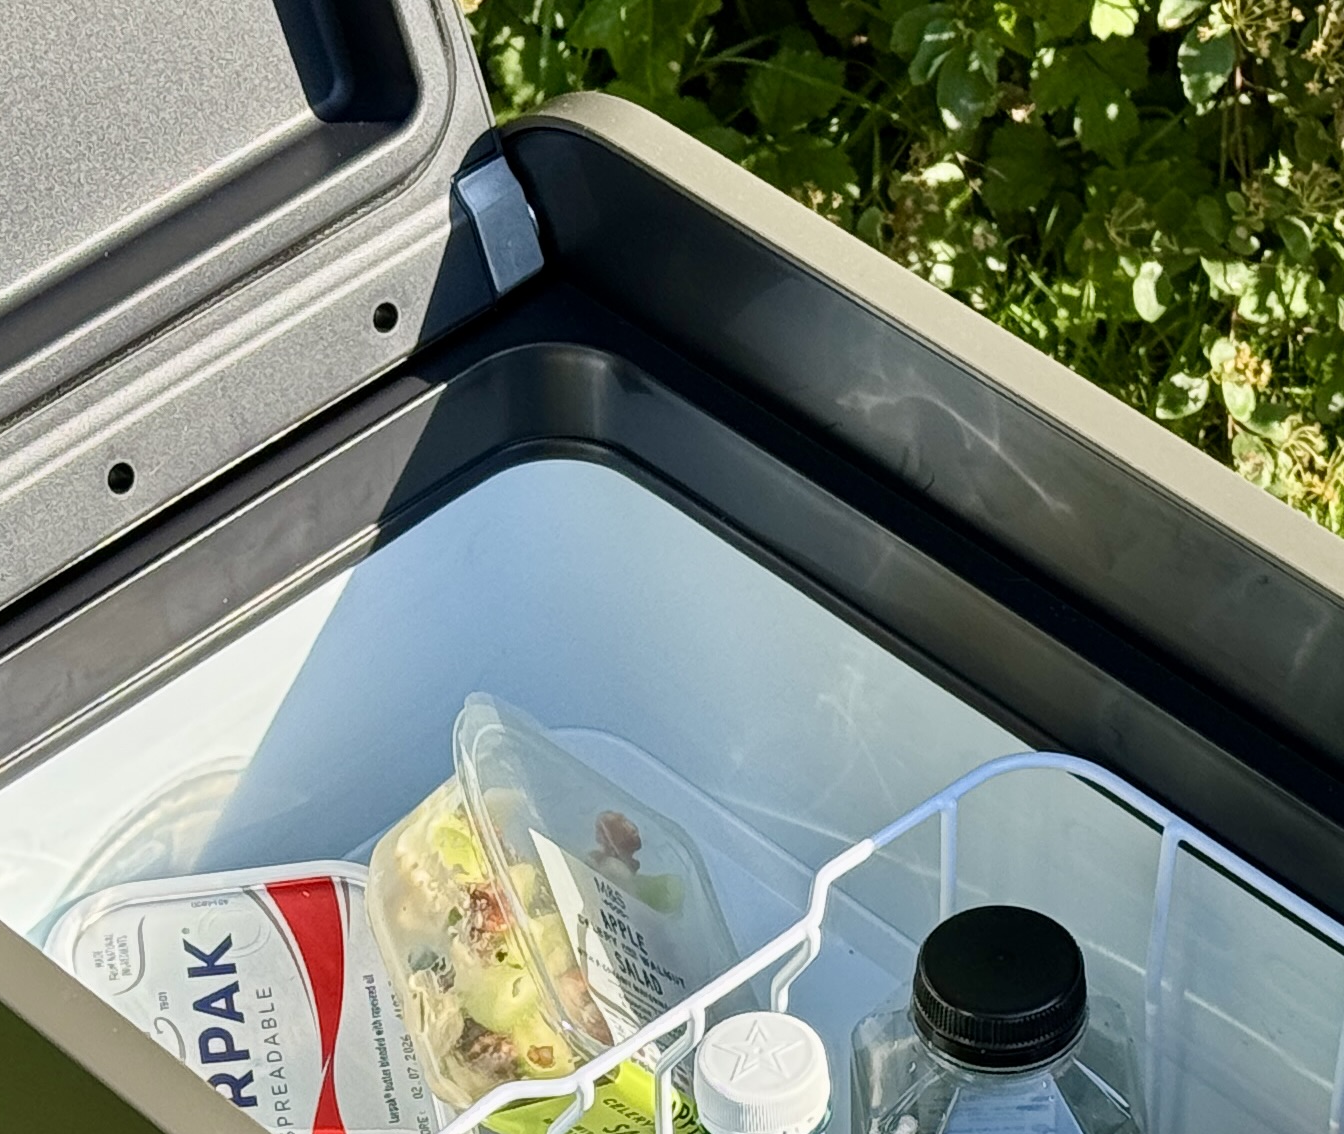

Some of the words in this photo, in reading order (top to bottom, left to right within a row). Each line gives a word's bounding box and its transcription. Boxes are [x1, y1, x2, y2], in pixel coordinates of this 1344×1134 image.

[600, 909, 648, 956] APPLE
[614, 951, 663, 995] SALAD
[602, 1097, 655, 1127] CELERY
